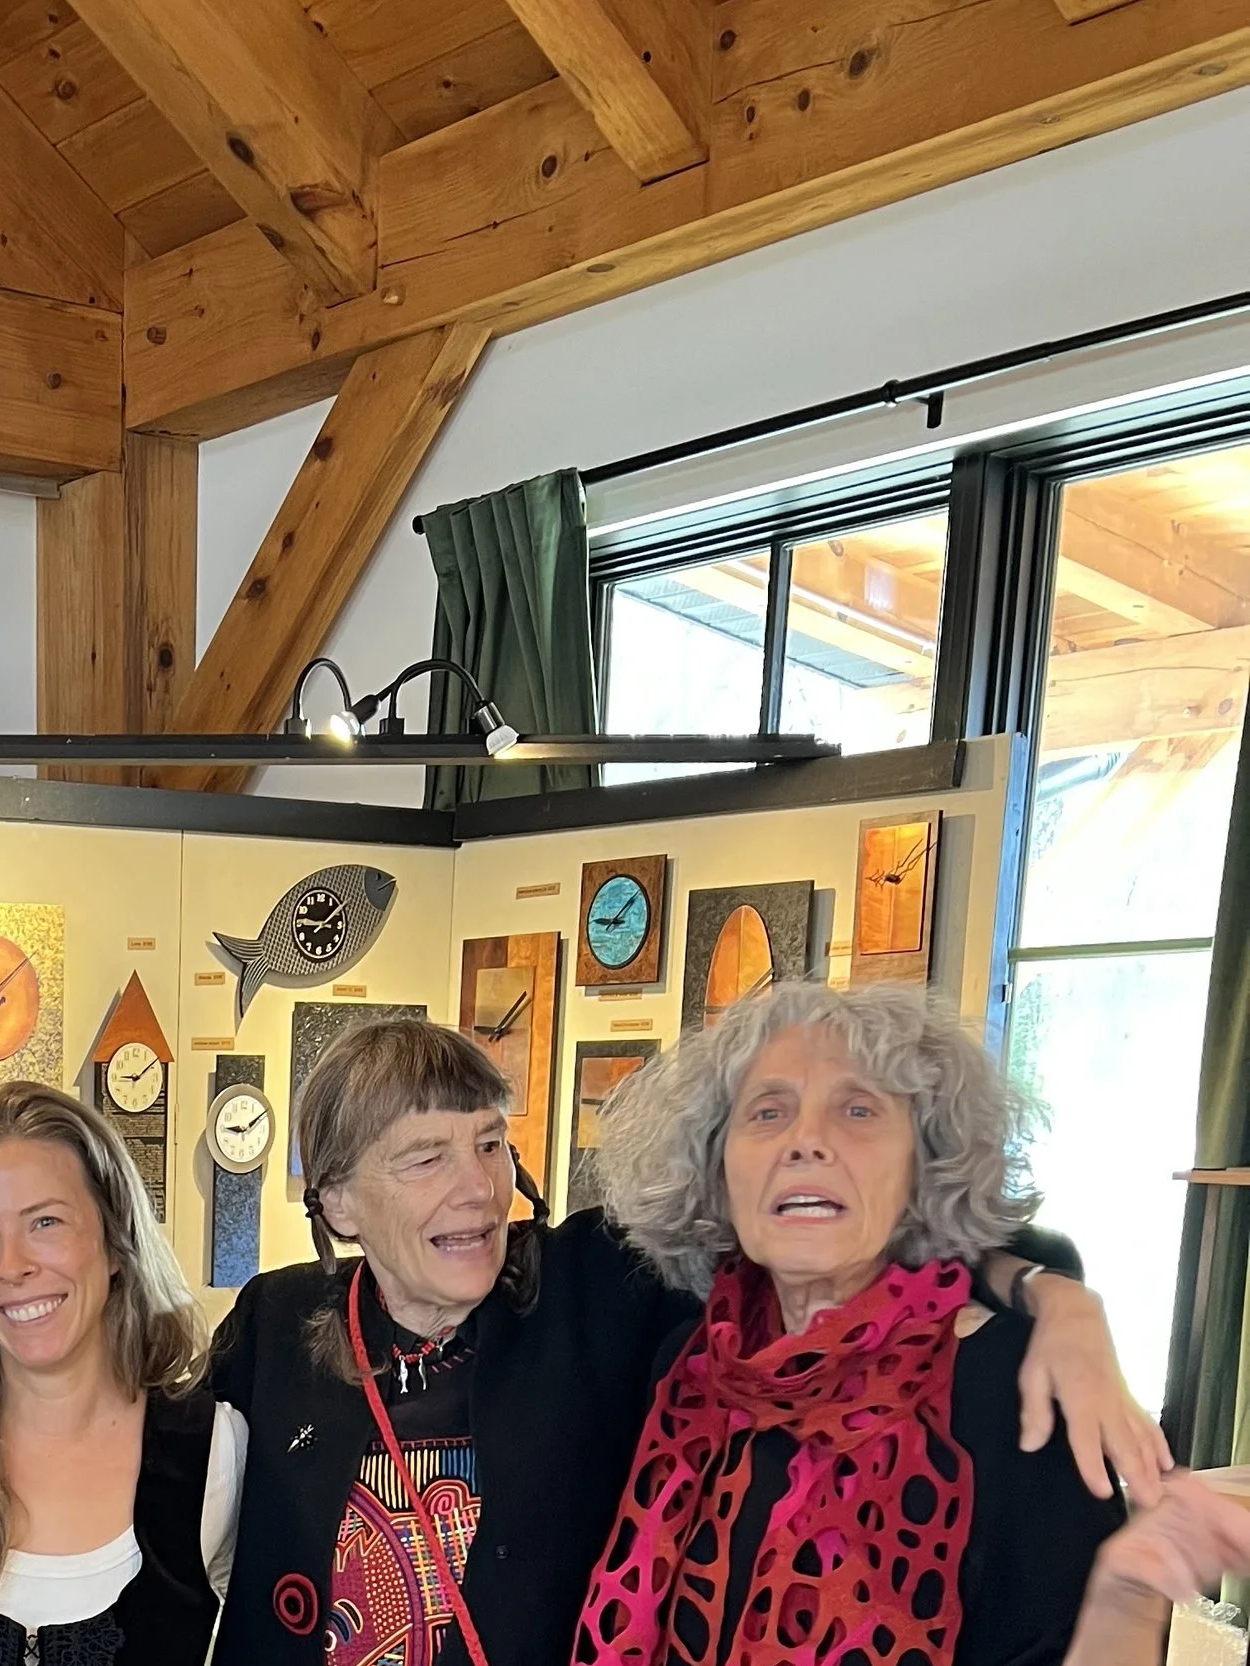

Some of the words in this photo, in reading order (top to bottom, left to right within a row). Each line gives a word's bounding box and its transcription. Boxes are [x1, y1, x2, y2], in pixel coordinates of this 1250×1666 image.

[307, 896, 314, 905] 11
[317, 894, 325, 902] 12
[329, 898, 332, 906] 1
[299, 906, 308, 914] 10
[337, 921, 342, 929] 3
[306, 942, 312, 951] 7
